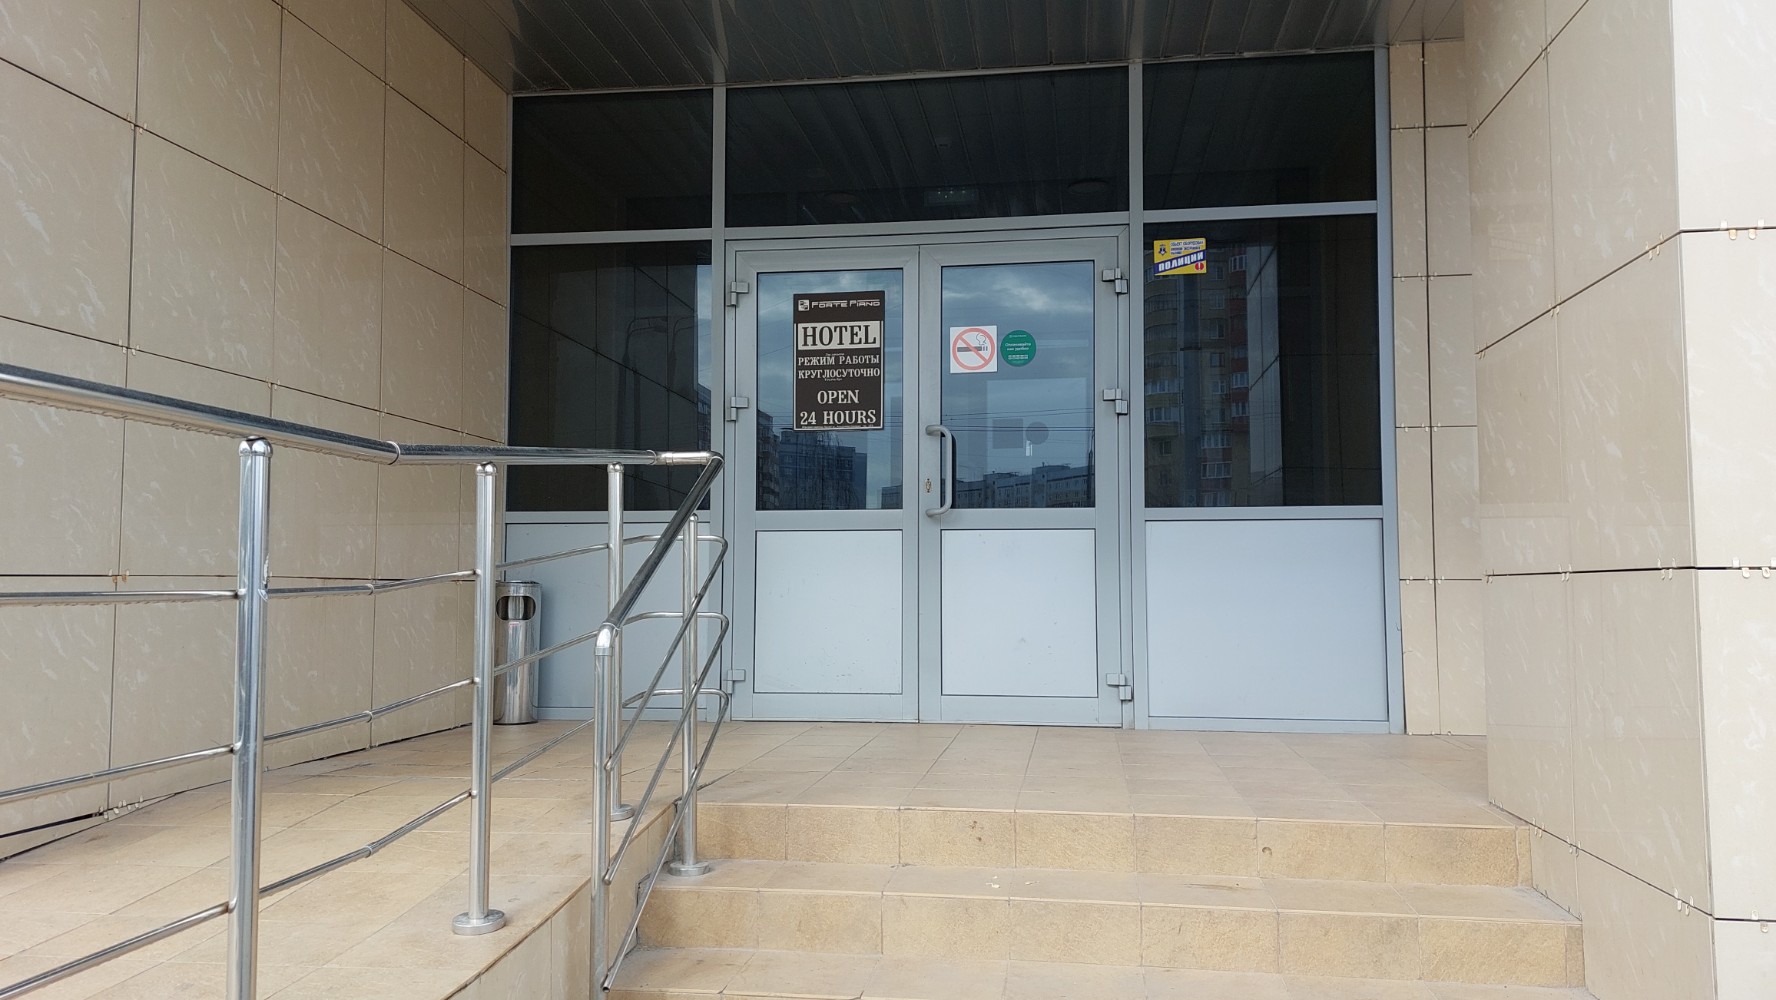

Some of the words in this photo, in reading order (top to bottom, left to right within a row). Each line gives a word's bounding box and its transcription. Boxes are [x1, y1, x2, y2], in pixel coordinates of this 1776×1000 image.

[1158, 251, 1204, 271] ПОЛИЦИИ
[811, 300, 848, 308] FORTE
[801, 324, 877, 347] HOTEL
[798, 356, 835, 366] РЕЖИМ
[839, 354, 880, 365] РАБОТЫ
[798, 367, 881, 379] КРУГЛОСУТОЧНО
[817, 390, 860, 404] OPEN
[800, 411, 817, 425] 24
[823, 410, 877, 425] HOURS
